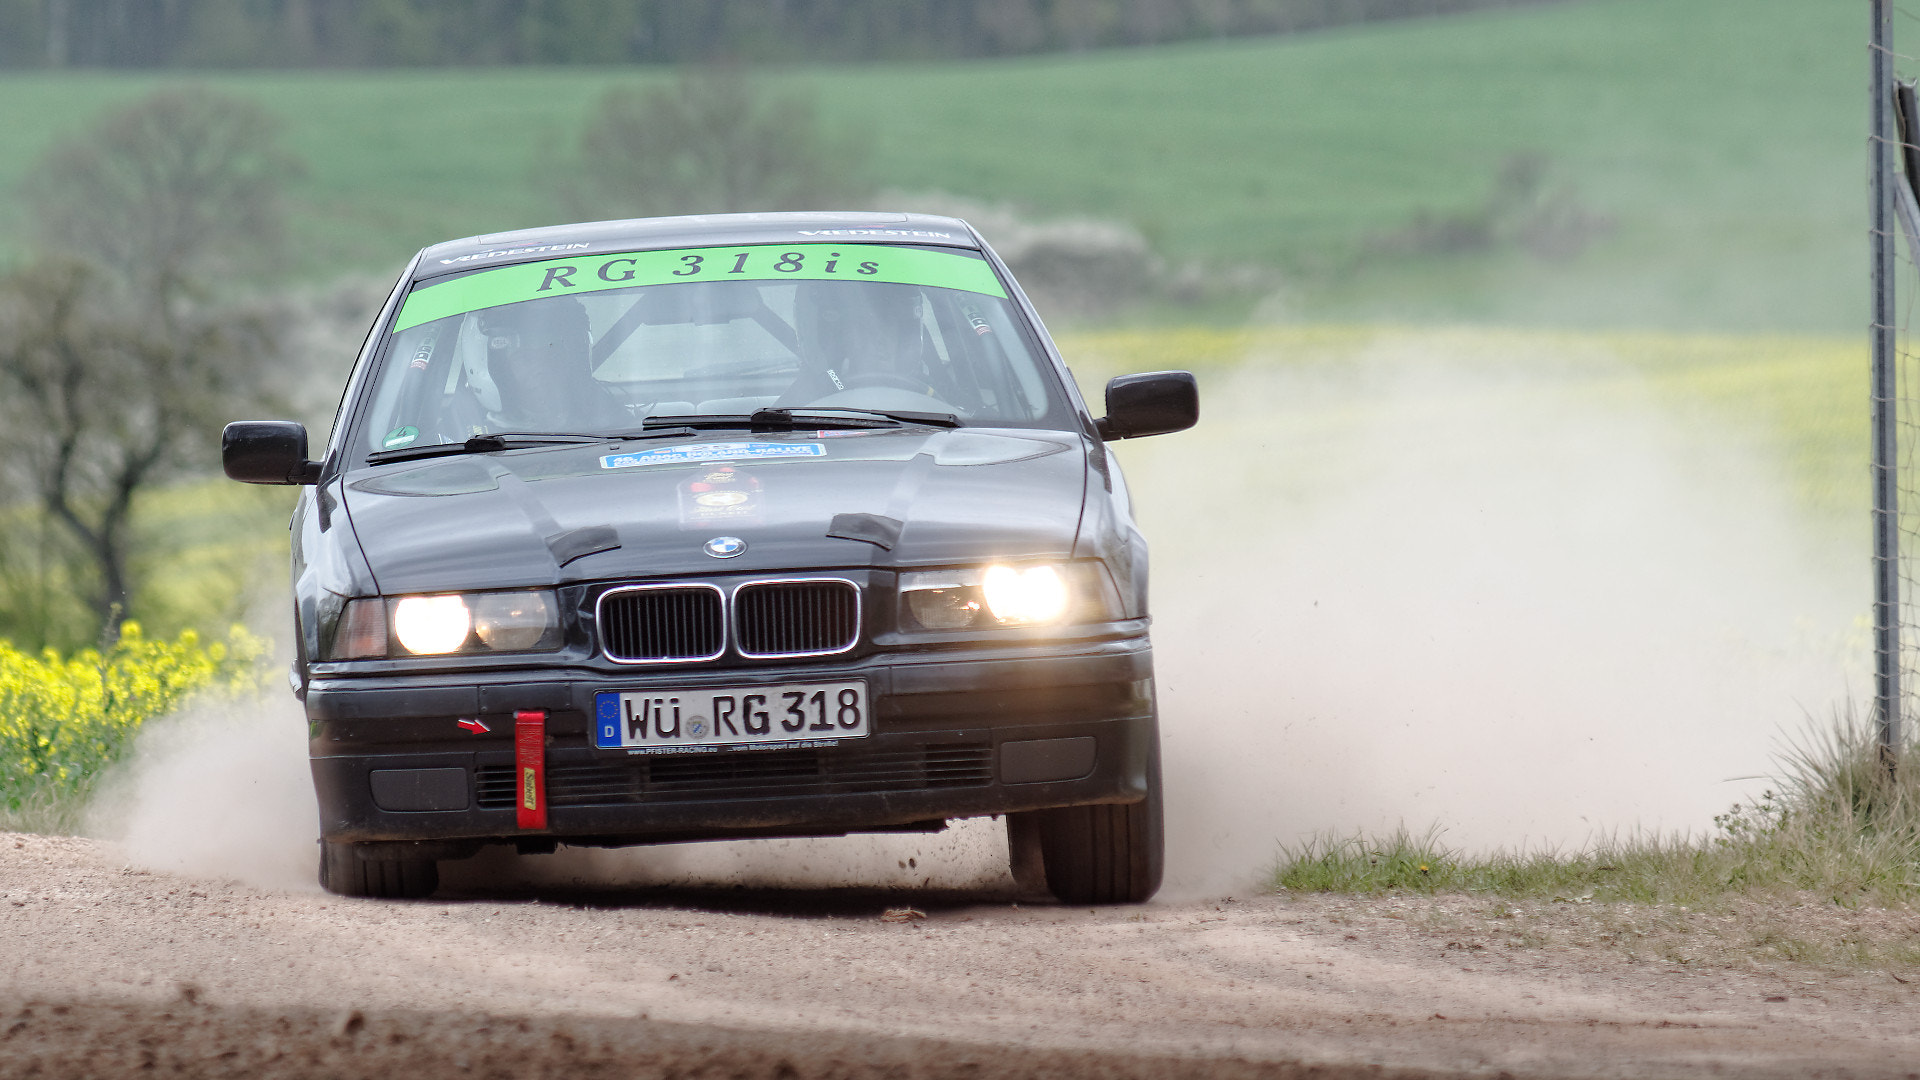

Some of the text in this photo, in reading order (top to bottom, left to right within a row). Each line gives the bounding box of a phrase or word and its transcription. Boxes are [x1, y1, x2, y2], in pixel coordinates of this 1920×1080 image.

[797, 229, 951, 239] VREDESTEIN
[439, 243, 590, 265] VREDESTEIN
[536, 252, 880, 292] RG 318is
[396, 426, 407, 437] 4
[625, 688, 861, 739] WÜ RG 318
[604, 725, 614, 738] D
